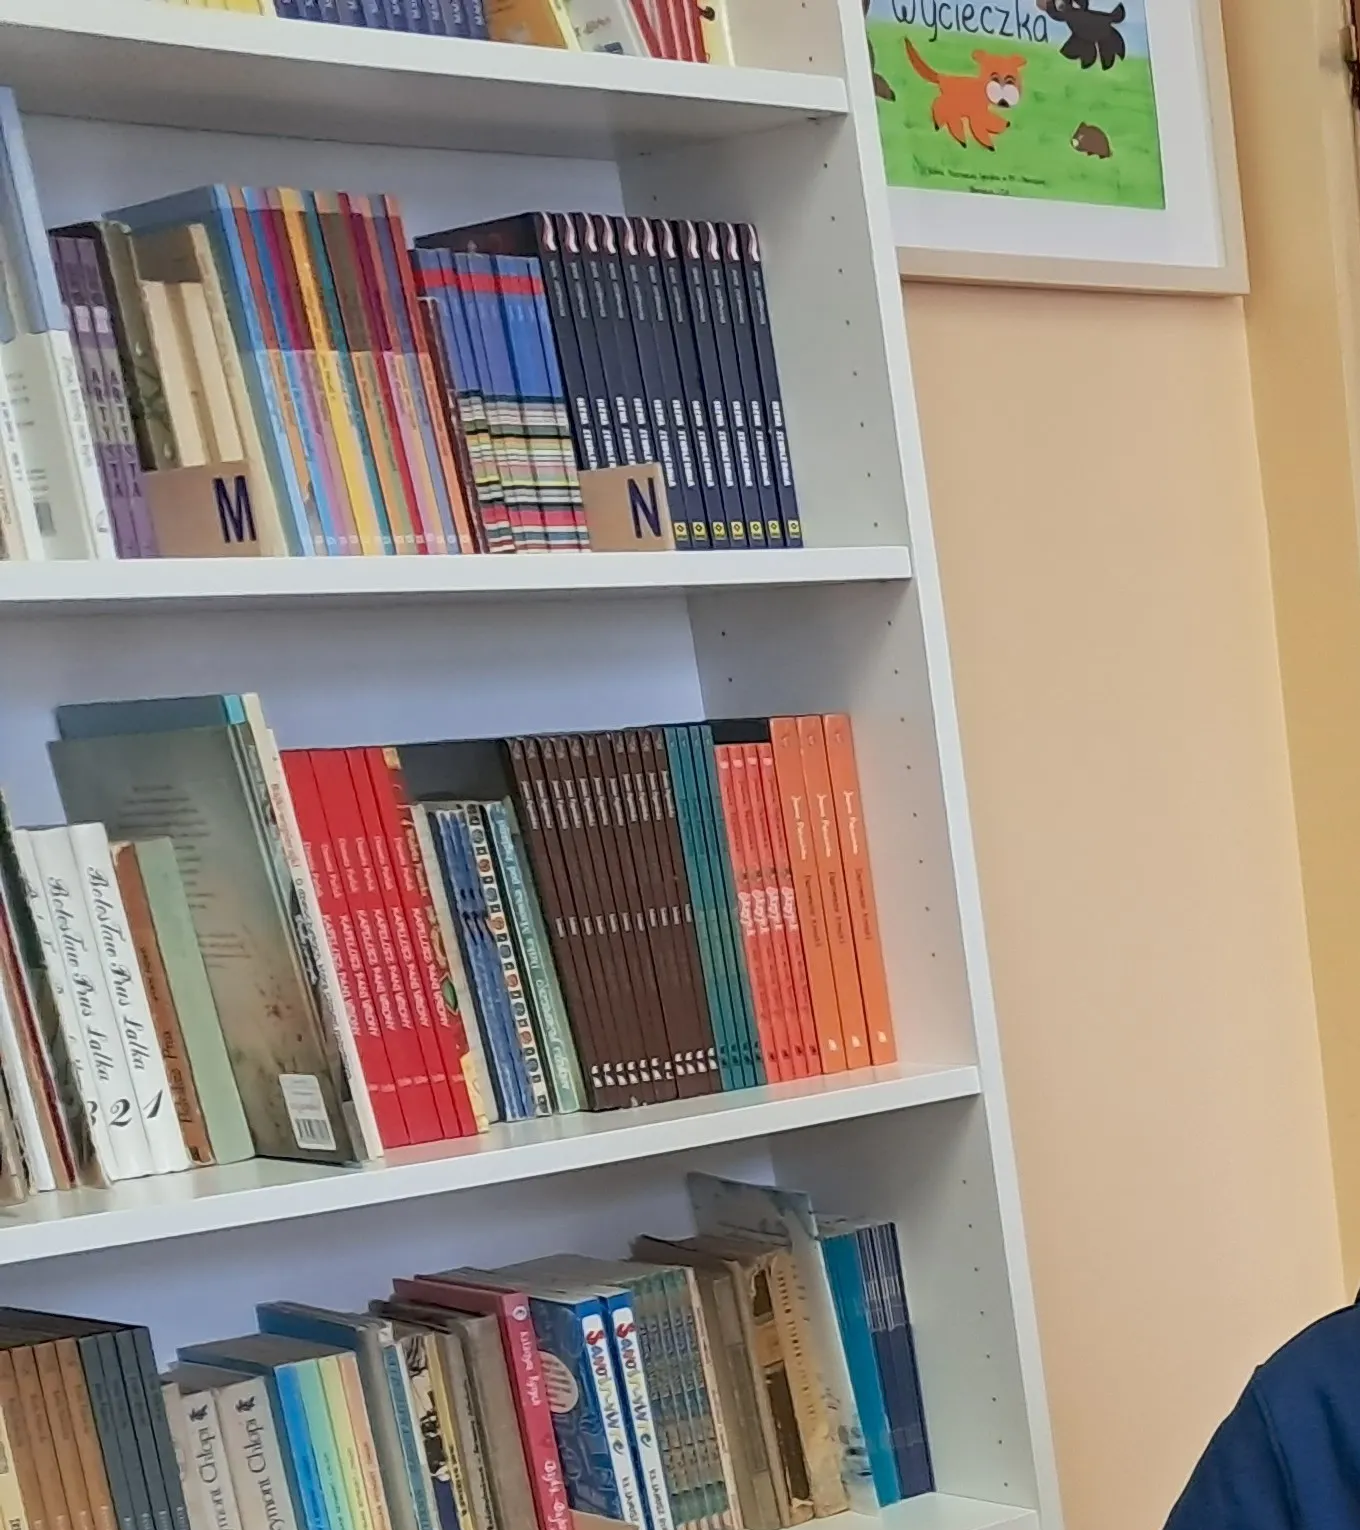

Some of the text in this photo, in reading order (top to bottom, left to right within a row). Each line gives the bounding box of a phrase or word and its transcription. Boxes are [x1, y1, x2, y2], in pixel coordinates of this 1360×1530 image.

[212, 475, 256, 543] M
[627, 478, 662, 538] N
[51, 882, 113, 1080] Bolesław Prus Lalka
[90, 871, 148, 1069] Bolesław Prus Lalka
[109, 1098, 133, 1129] 2
[143, 1089, 163, 1120] 1
[197, 1427, 218, 1484] Chłopi
[246, 1418, 266, 1473] Chłopi
